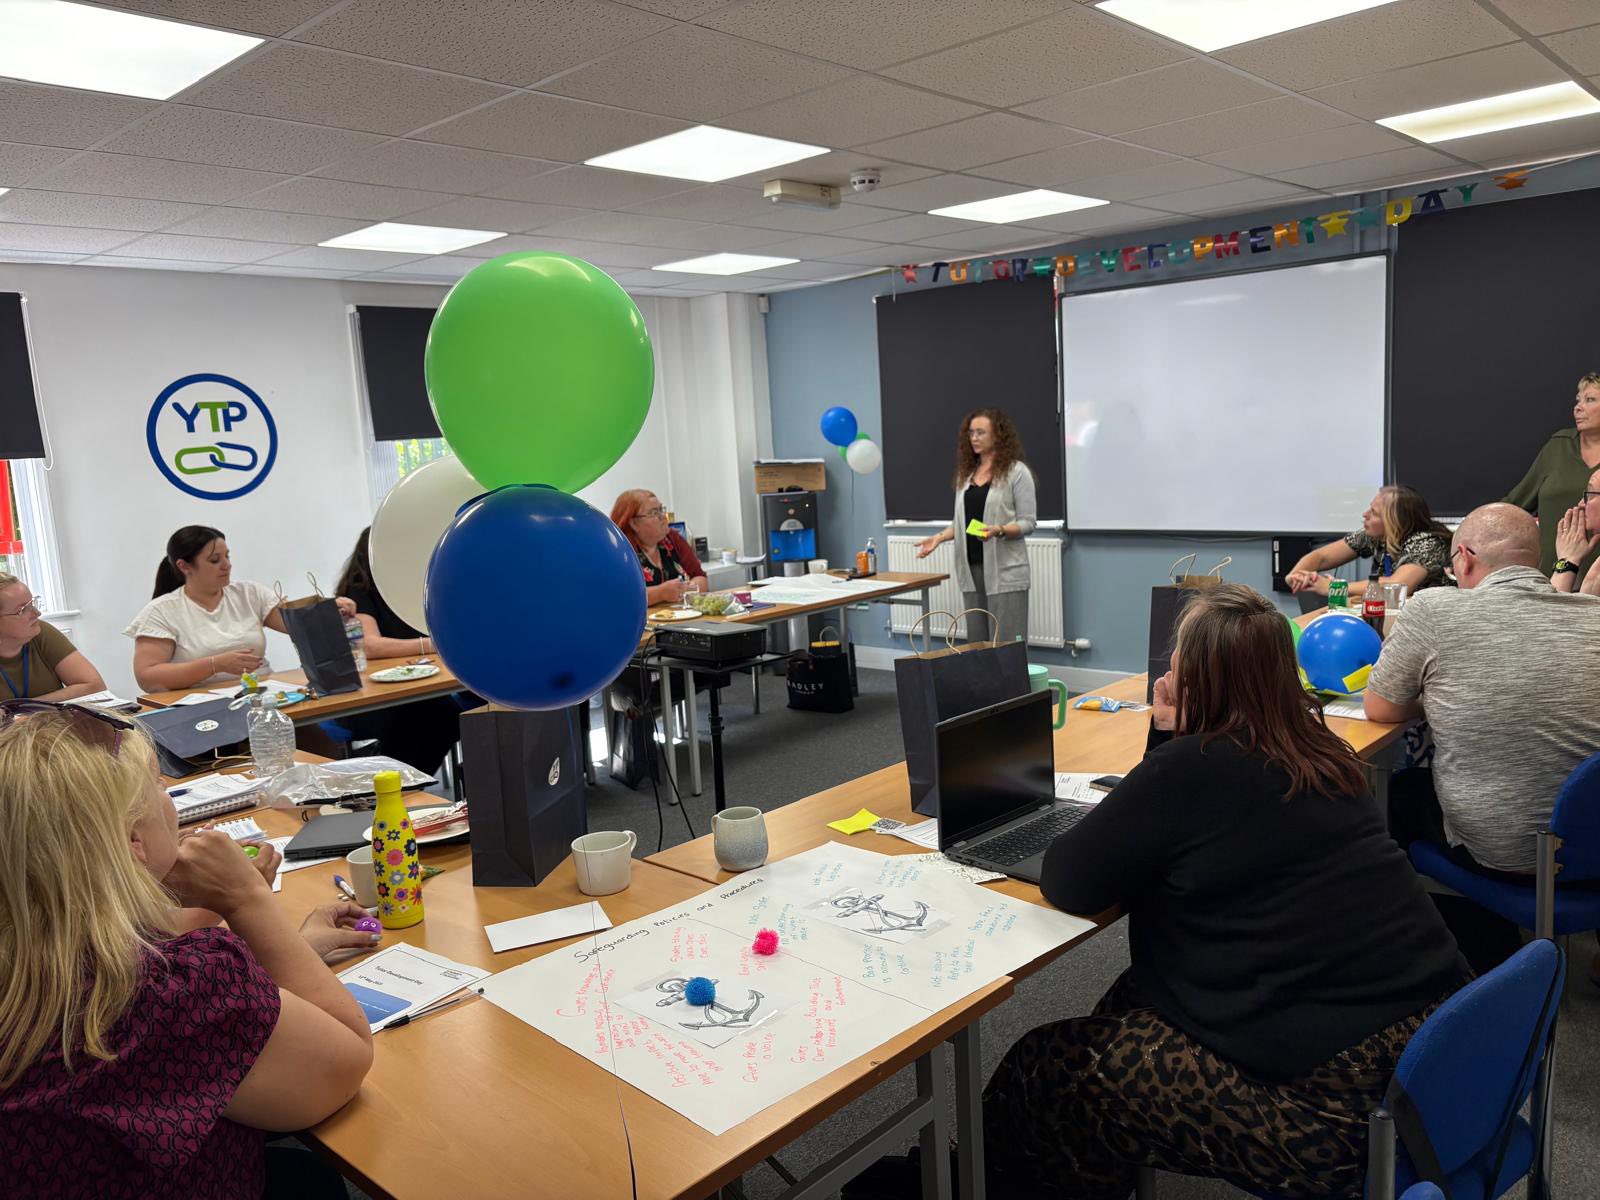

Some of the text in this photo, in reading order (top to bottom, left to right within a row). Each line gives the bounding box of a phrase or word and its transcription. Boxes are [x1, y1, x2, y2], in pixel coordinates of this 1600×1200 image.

[1386, 182, 1480, 226] DAY
[172, 401, 248, 433] YTP
[573, 928, 650, 964] Safeguarding
[696, 902, 714, 912] and
[387, 970, 414, 983] Development
[862, 965, 875, 979] Bad
